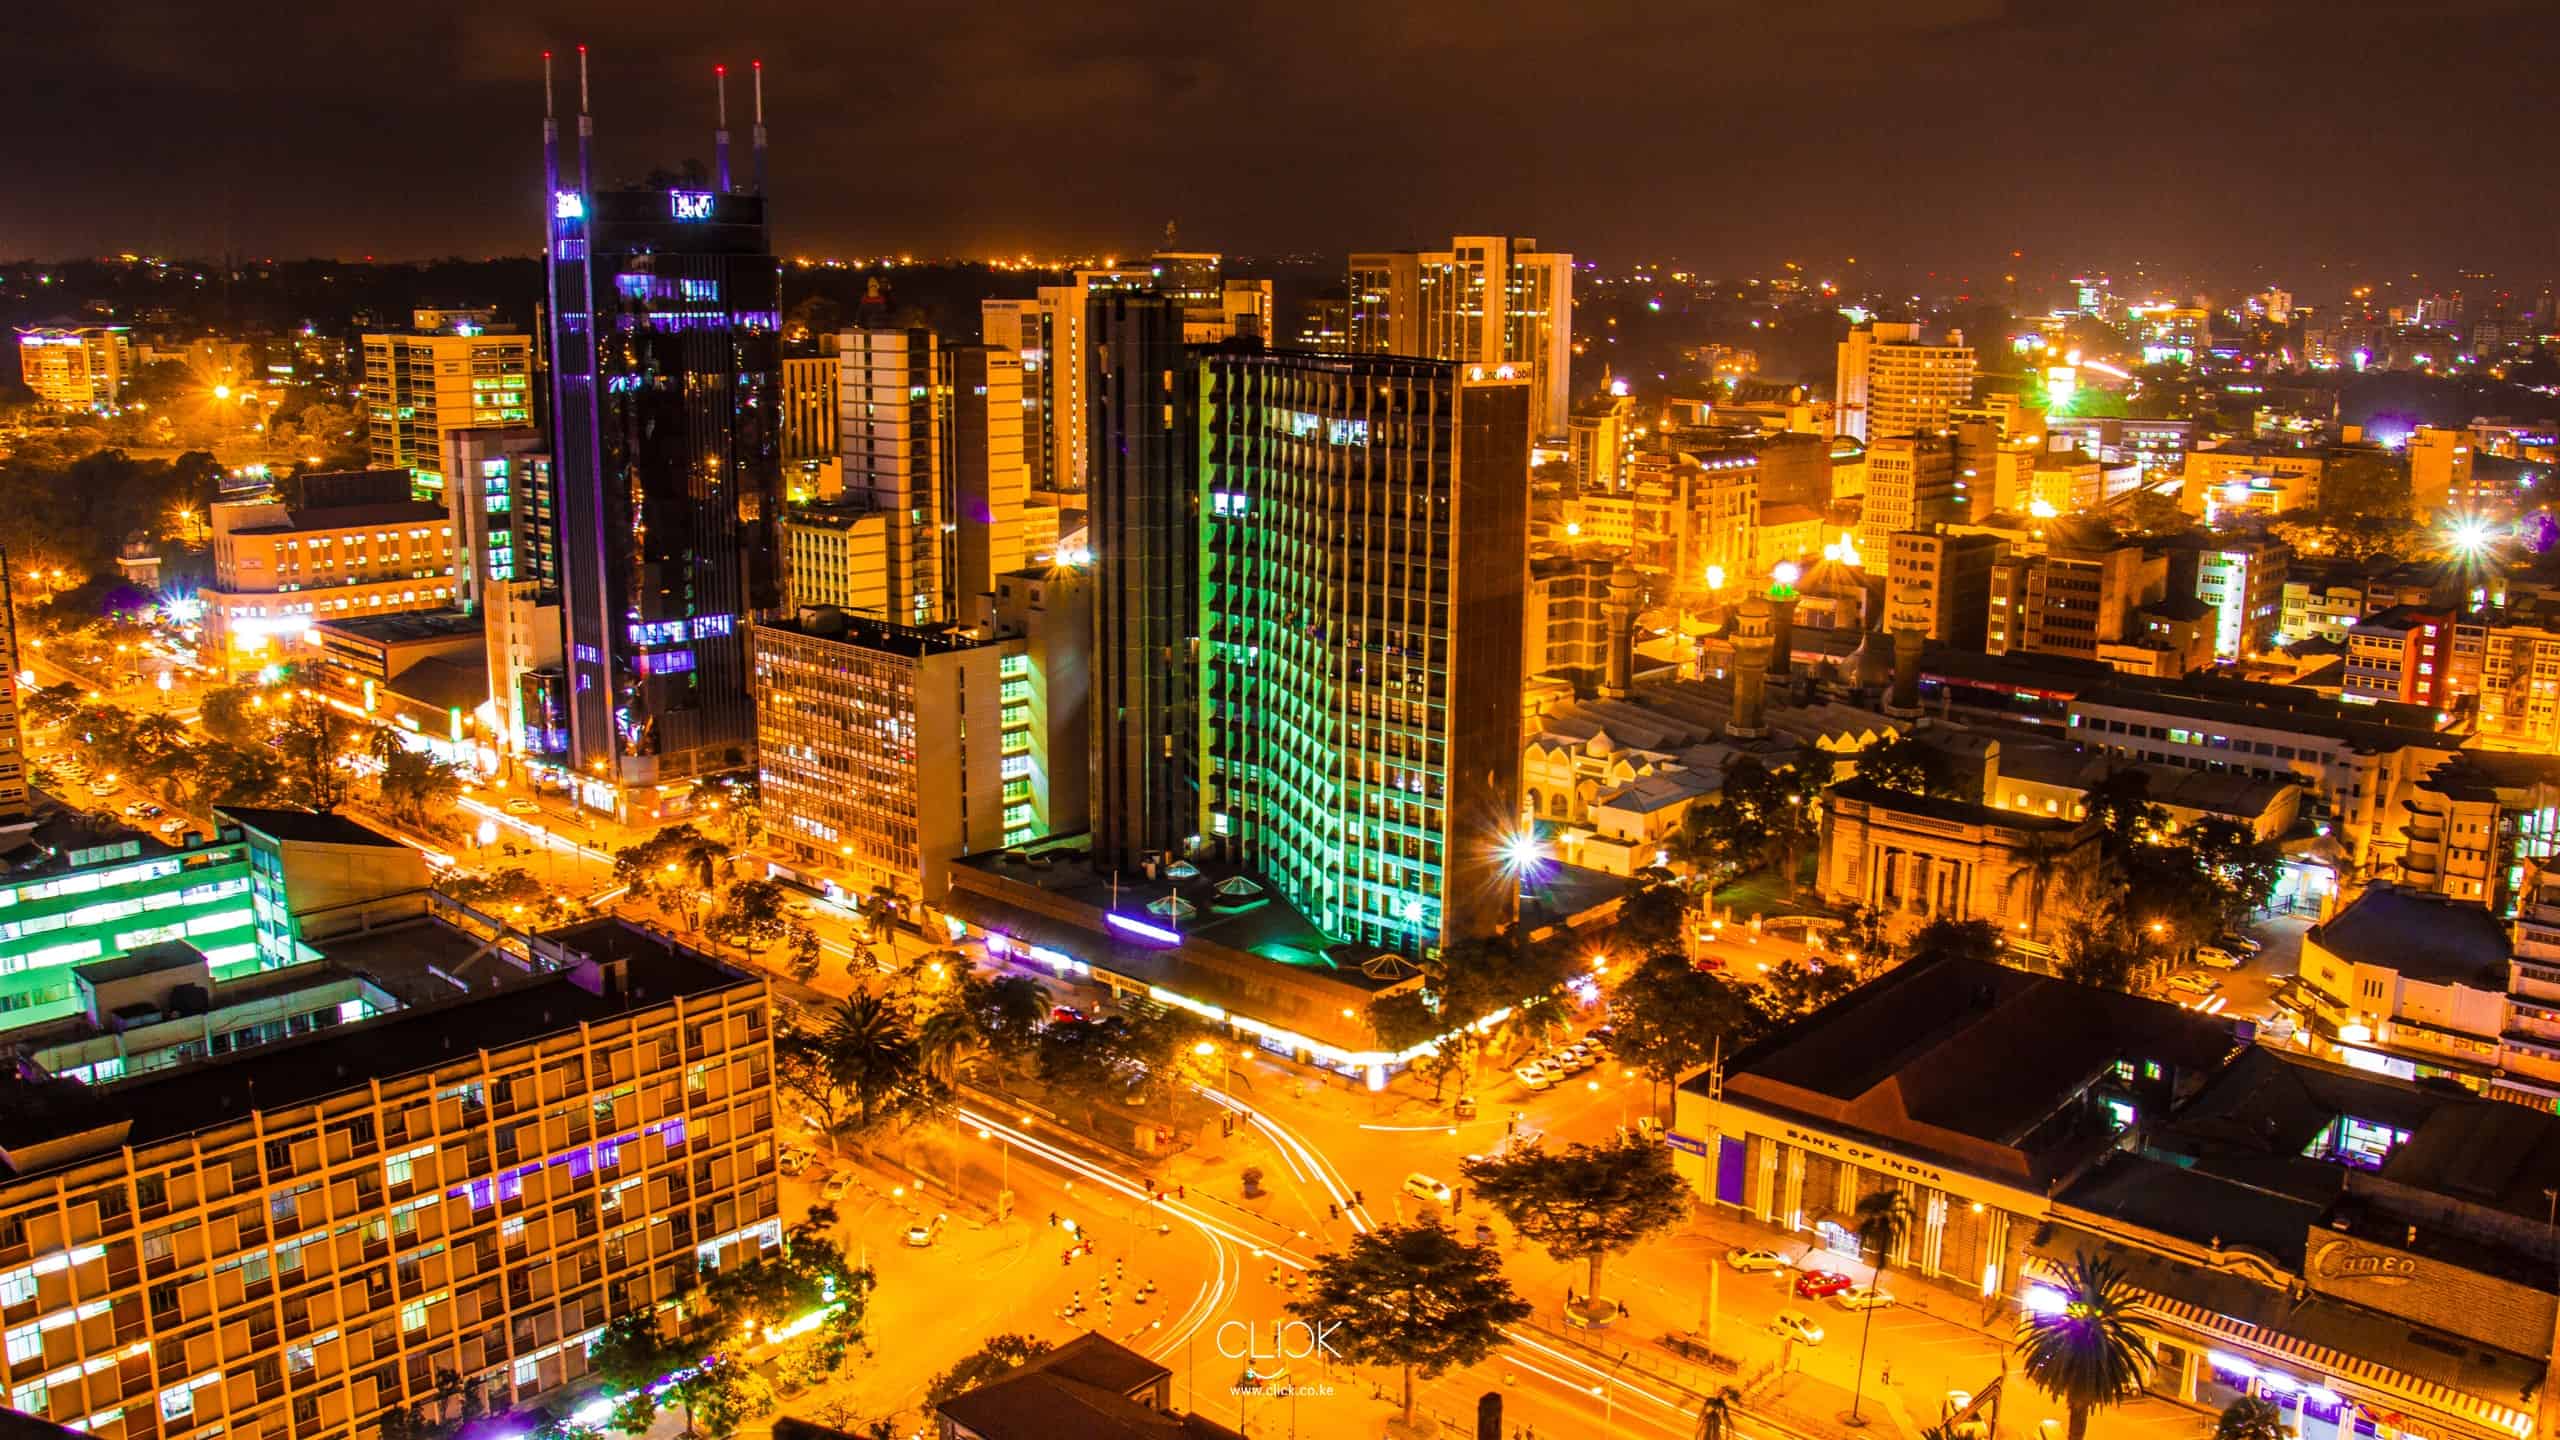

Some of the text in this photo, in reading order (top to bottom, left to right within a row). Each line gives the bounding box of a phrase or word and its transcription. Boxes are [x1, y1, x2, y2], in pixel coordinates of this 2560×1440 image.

[1786, 1129, 1942, 1182] BANK OF INDIA
